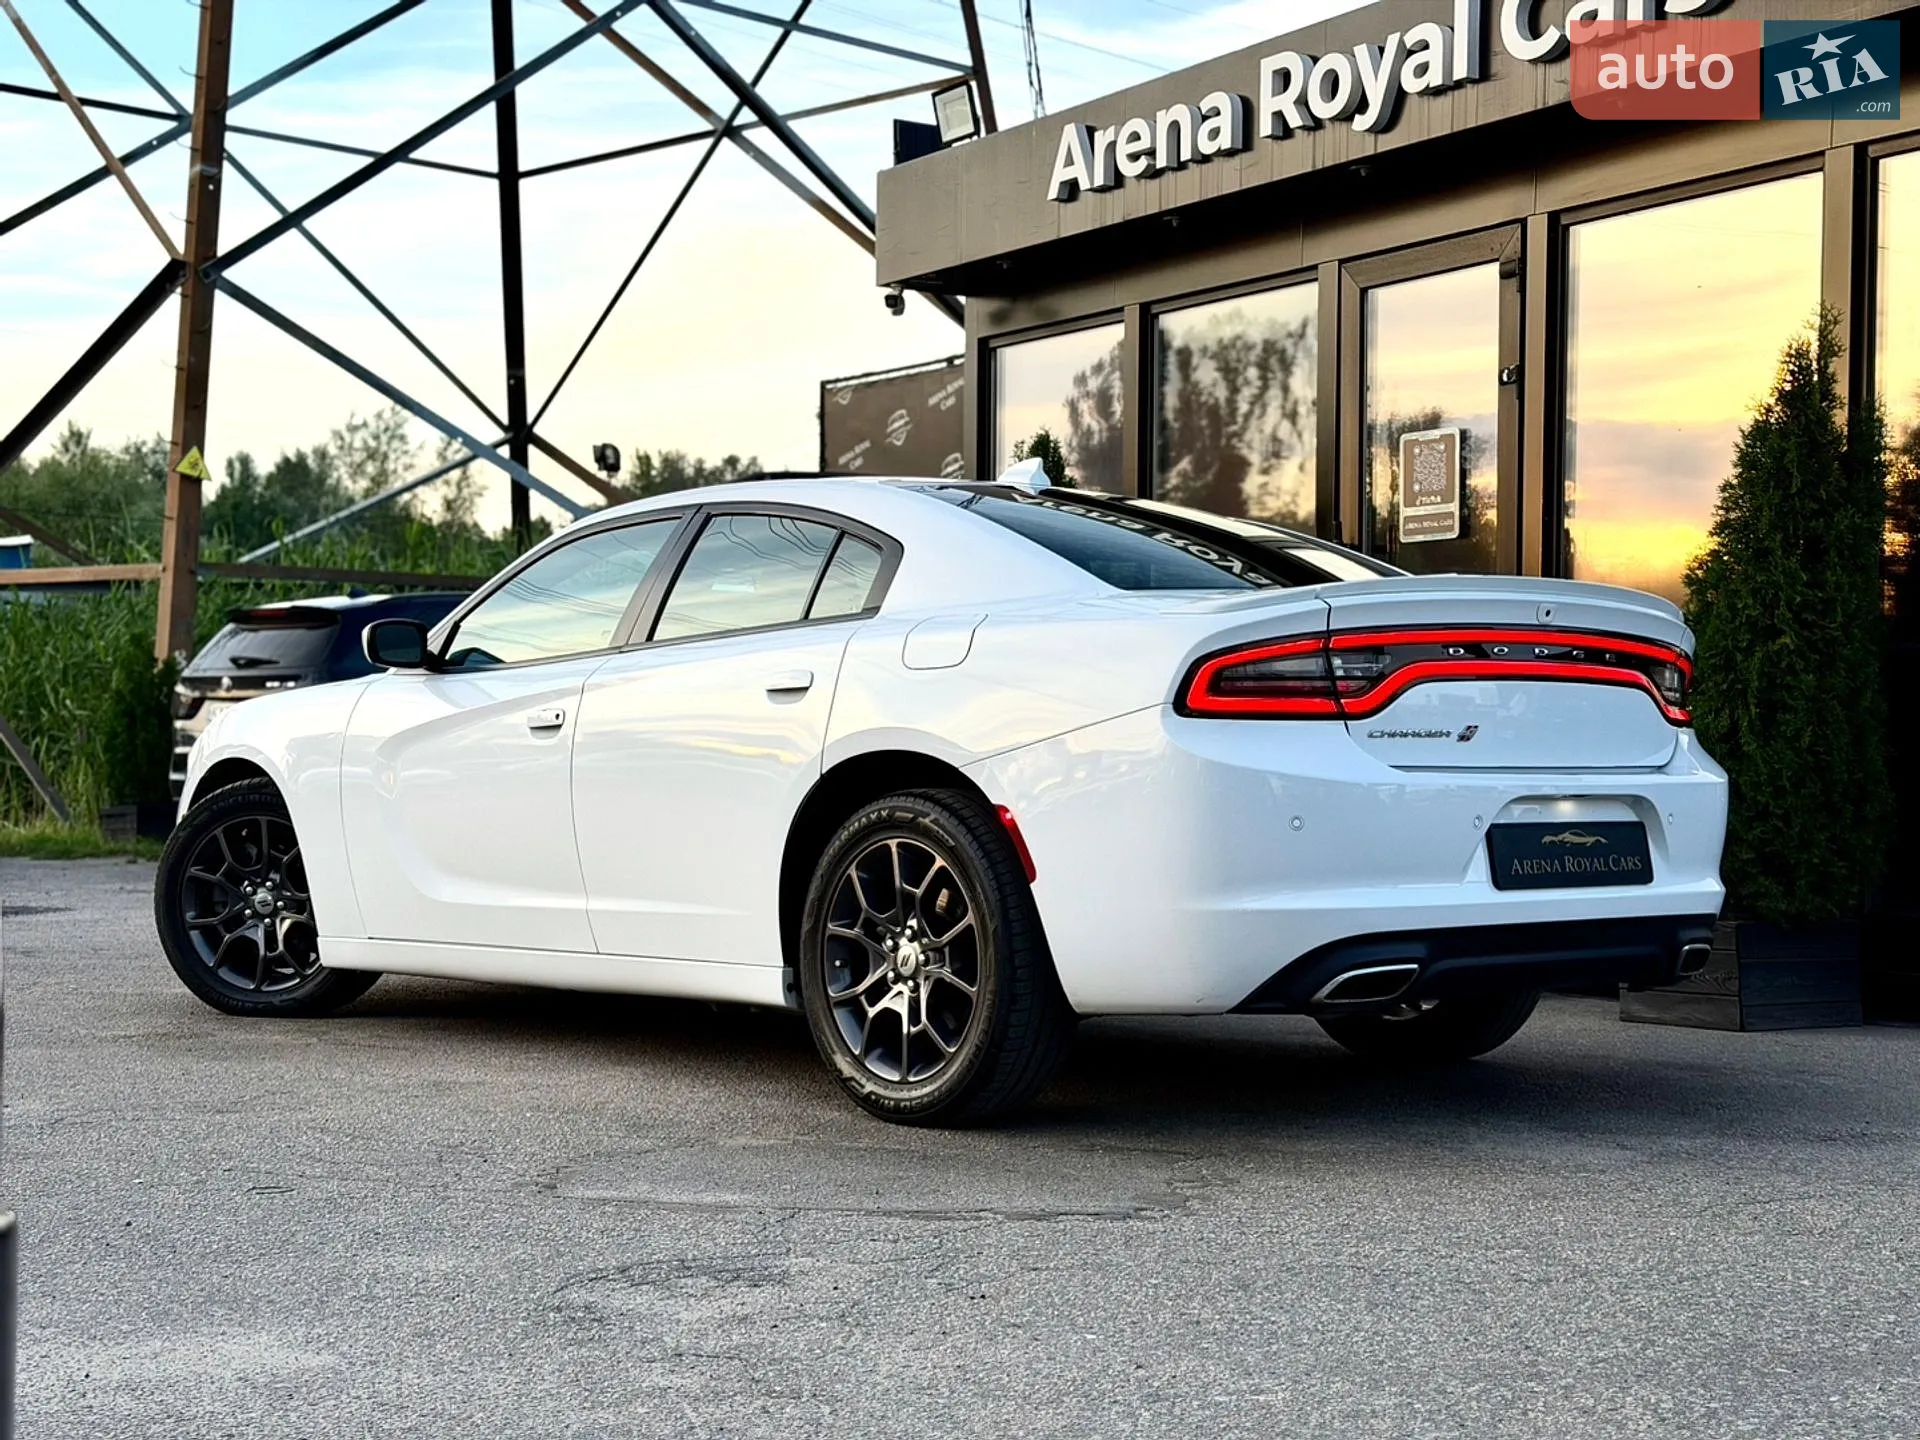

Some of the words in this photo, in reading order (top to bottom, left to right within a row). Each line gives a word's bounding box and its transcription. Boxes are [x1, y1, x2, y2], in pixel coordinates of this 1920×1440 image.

[1047, 91, 1242, 201] Arena
[1259, 0, 1478, 138] Royal
[1500, 0, 1708, 61] Ca
[1511, 858, 1562, 875] ARENA
[1564, 855, 1608, 873] ROYAL
[1609, 854, 1642, 871] CARS
